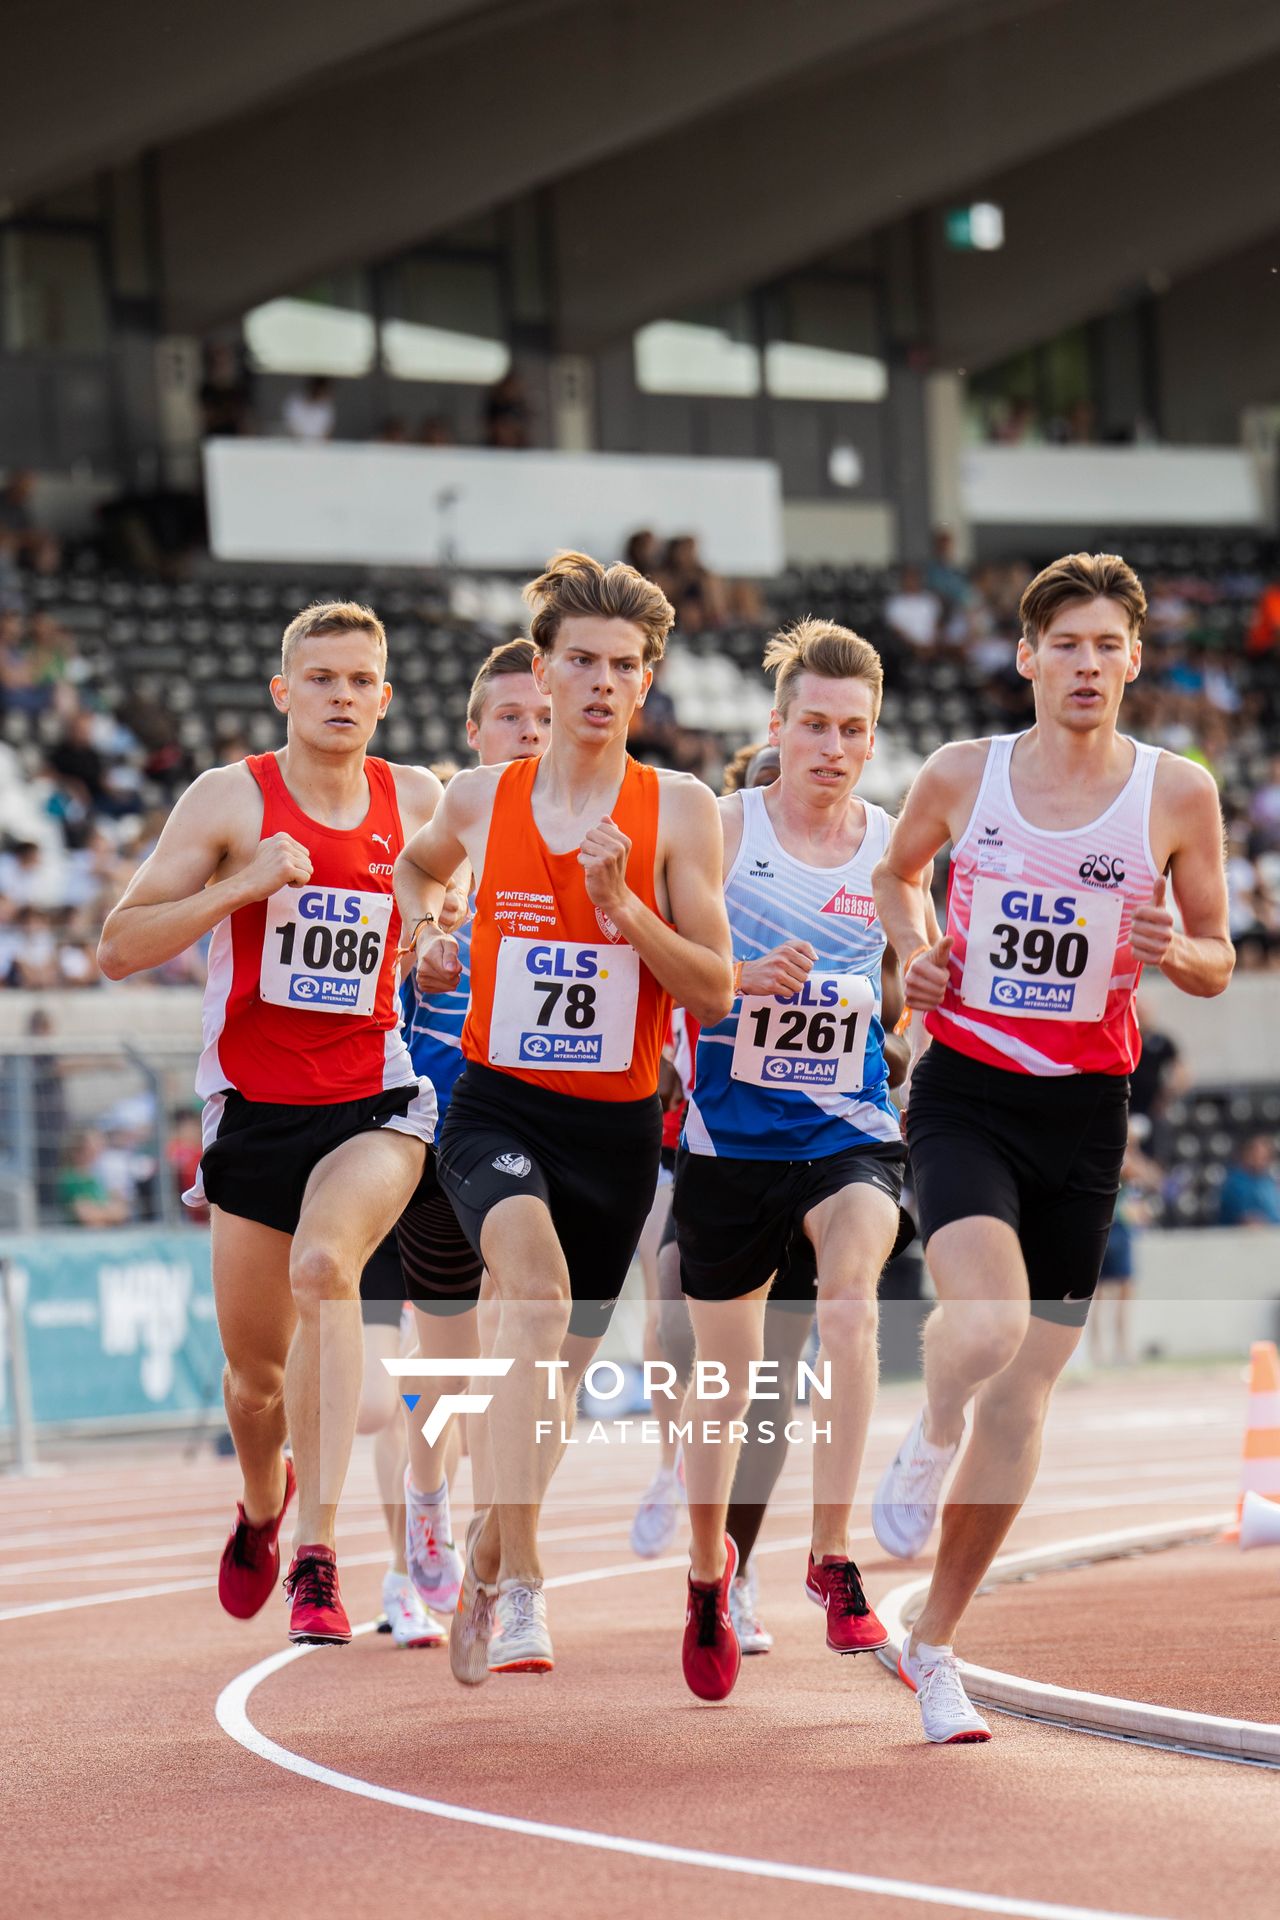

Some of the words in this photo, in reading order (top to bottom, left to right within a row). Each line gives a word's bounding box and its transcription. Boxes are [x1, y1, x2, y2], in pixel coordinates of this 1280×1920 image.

[978, 837, 1003, 846] erima
[750, 870, 774, 878] erima
[504, 891, 553, 903] INTERSPORT
[518, 923, 539, 932] Team
[275, 922, 381, 975] 1086
[989, 923, 1089, 978] 390
[322, 981, 358, 997] PLAN
[1025, 986, 1072, 1003] PLAN
[533, 980, 597, 1030] 78
[1024, 1000, 1068, 1009] INTERNATIONAL
[750, 1006, 859, 1054] 1261
[554, 1039, 599, 1053] PLAN
[794, 1061, 836, 1076] PLAN
[793, 1074, 833, 1082] INTERNATIONAL
